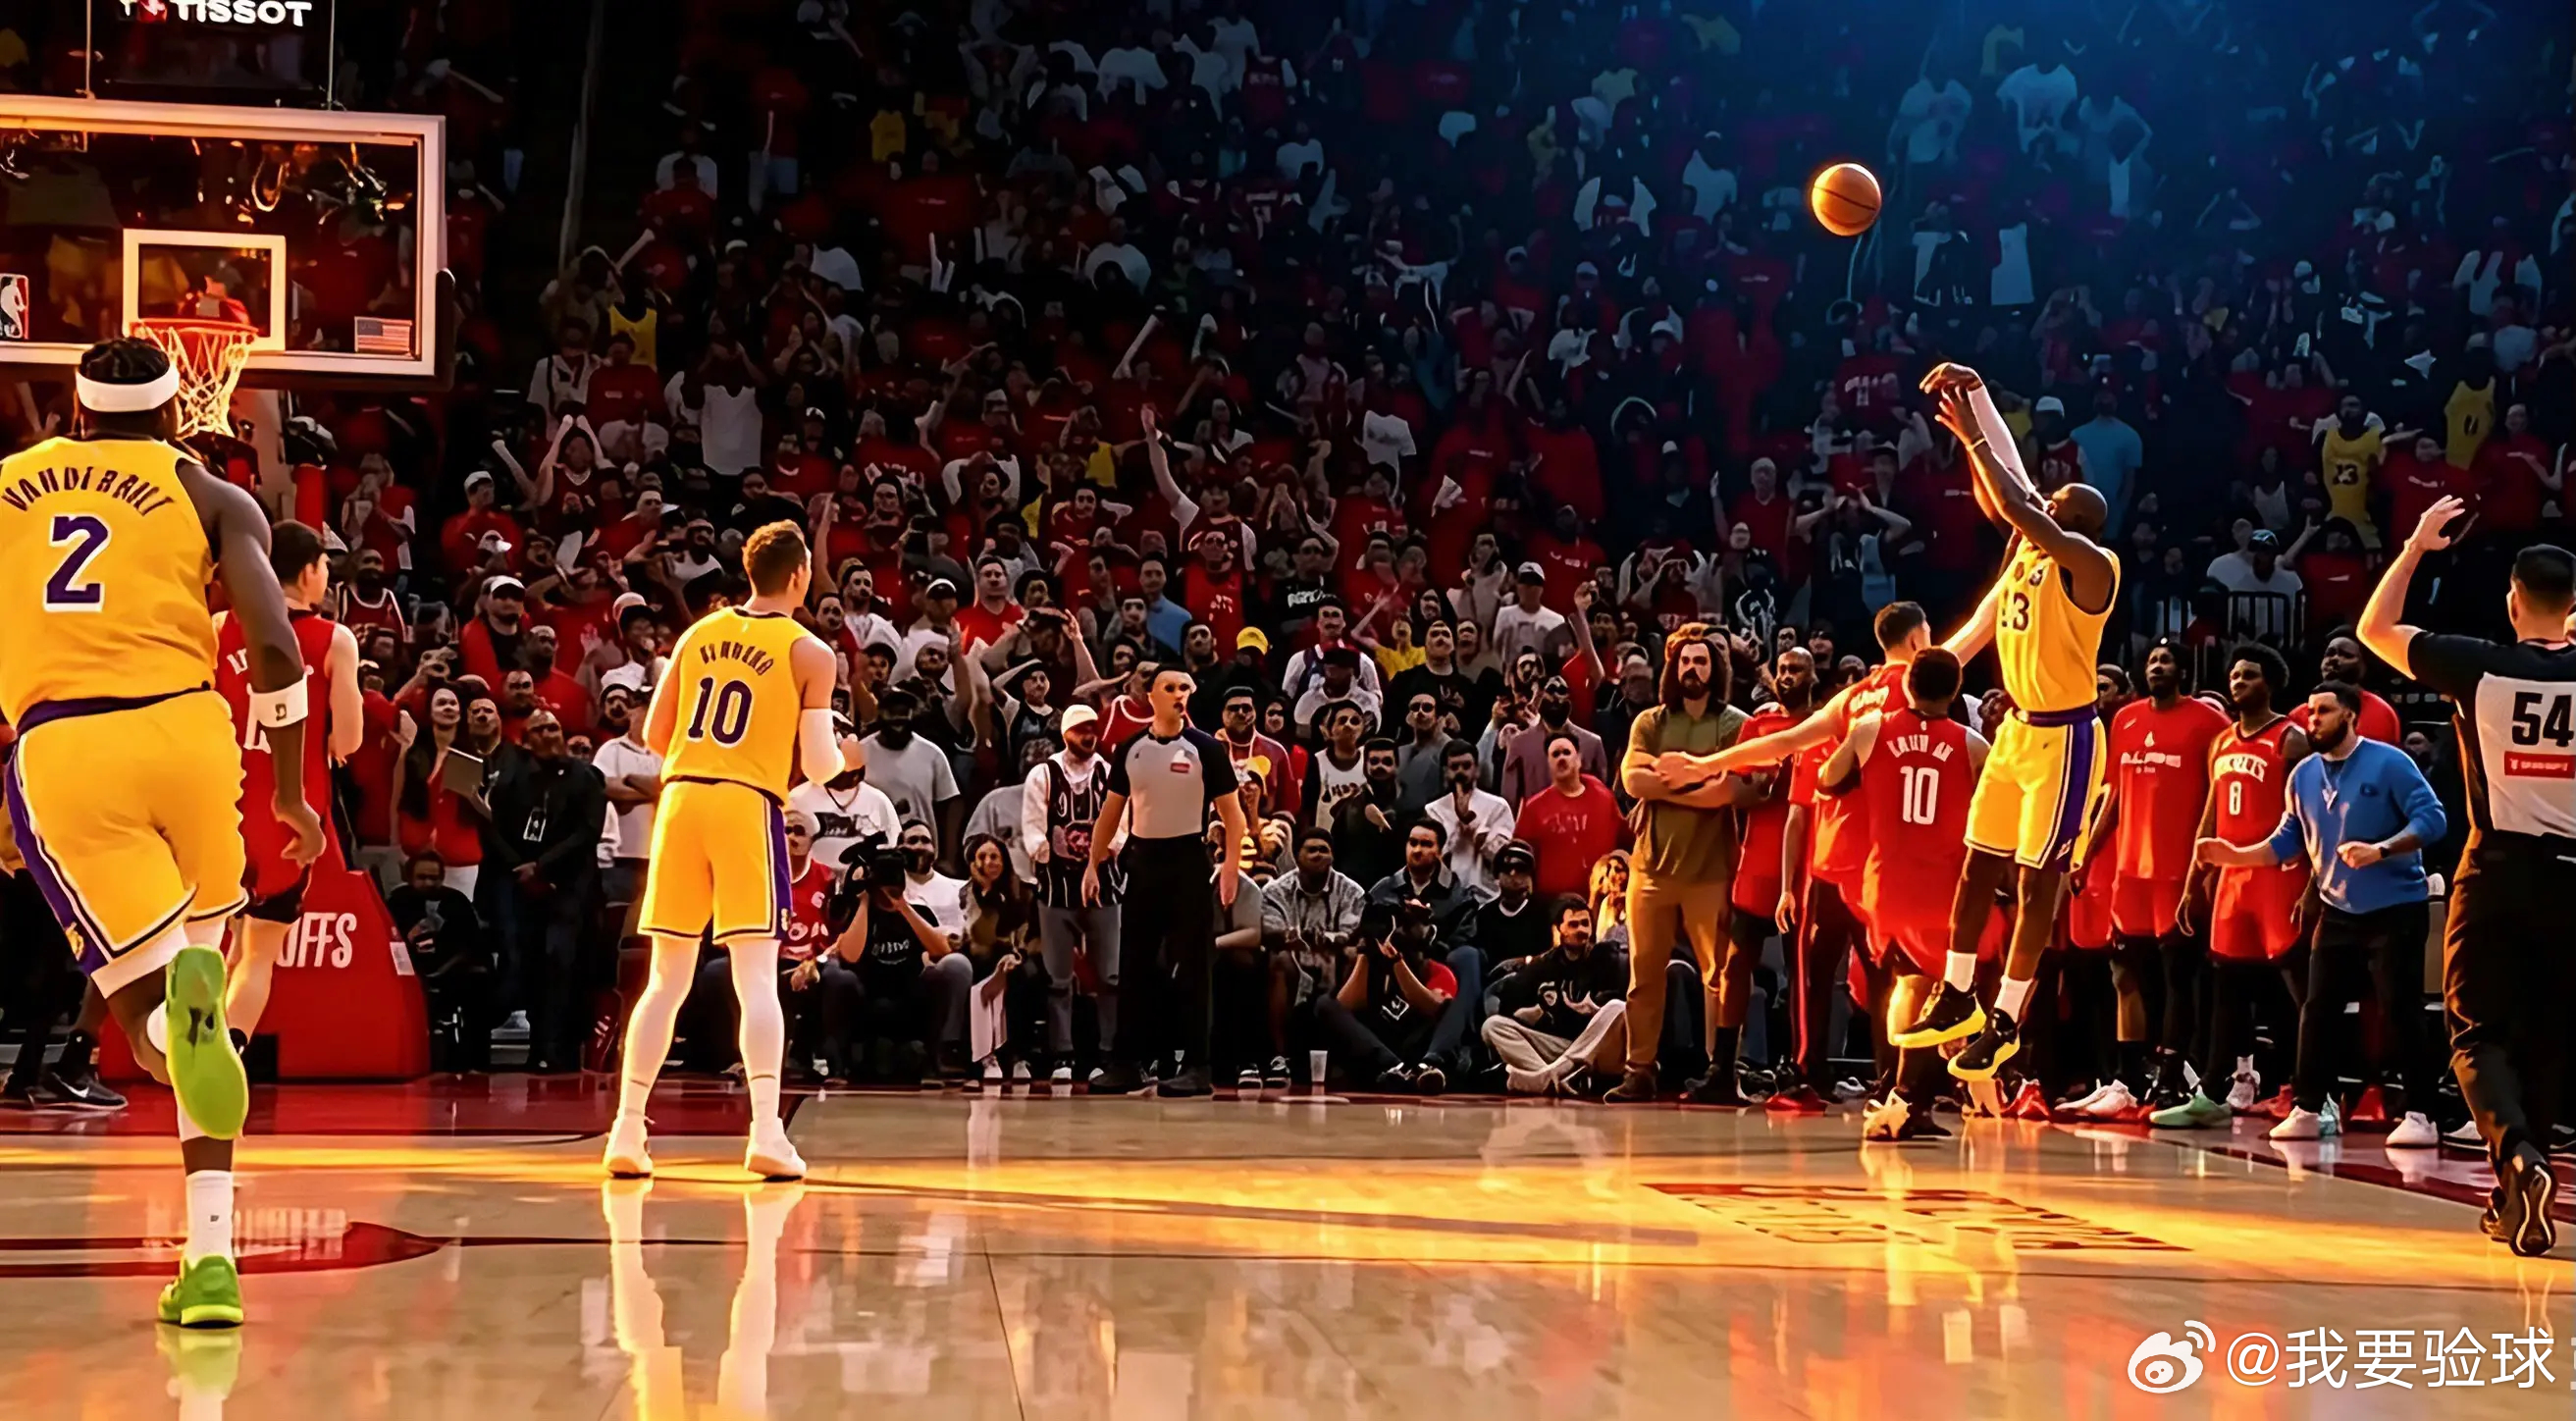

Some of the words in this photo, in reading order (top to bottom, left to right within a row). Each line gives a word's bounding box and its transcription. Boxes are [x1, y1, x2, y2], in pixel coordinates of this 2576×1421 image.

[169, 0, 312, 26] TISSOT
[44, 511, 112, 611] 2
[688, 677, 754, 746] 10
[2512, 691, 2575, 748] 54
[1900, 765, 1939, 825] 10
